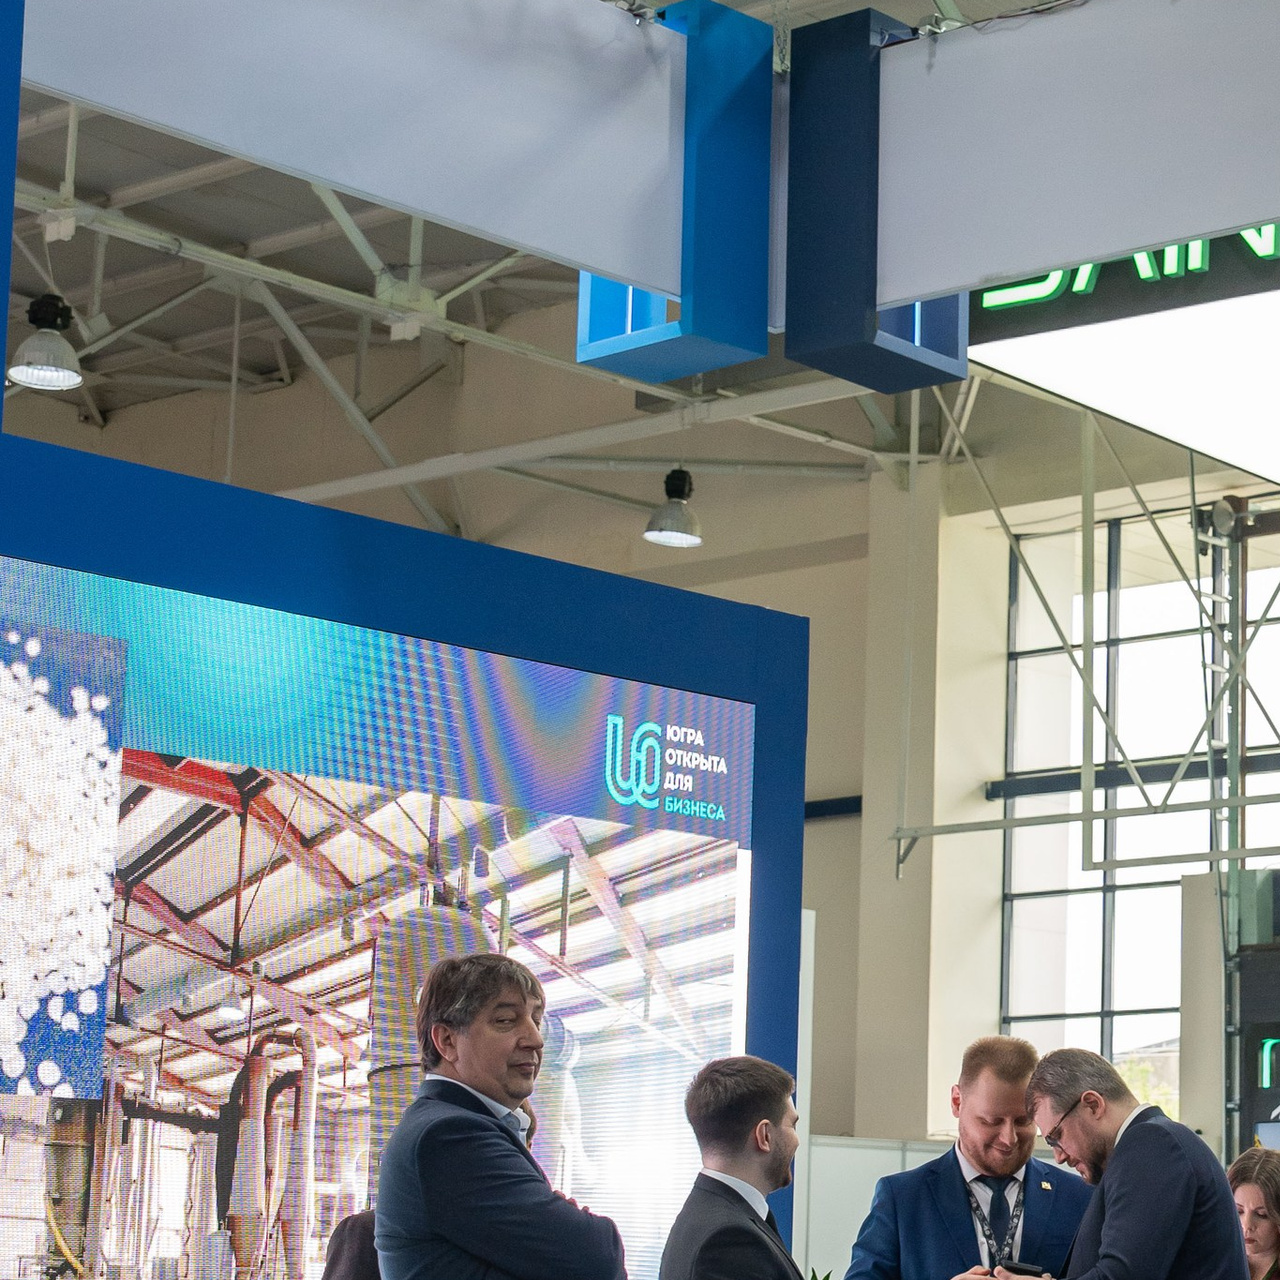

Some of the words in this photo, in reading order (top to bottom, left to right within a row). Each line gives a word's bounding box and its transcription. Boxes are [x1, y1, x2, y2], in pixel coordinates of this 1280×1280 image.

[666, 724, 705, 747] ЮГРА
[665, 748, 728, 775] ОТКРЫТА
[663, 771, 693, 793] ДЛЯ
[664, 796, 726, 822] БИЗНЕСА
